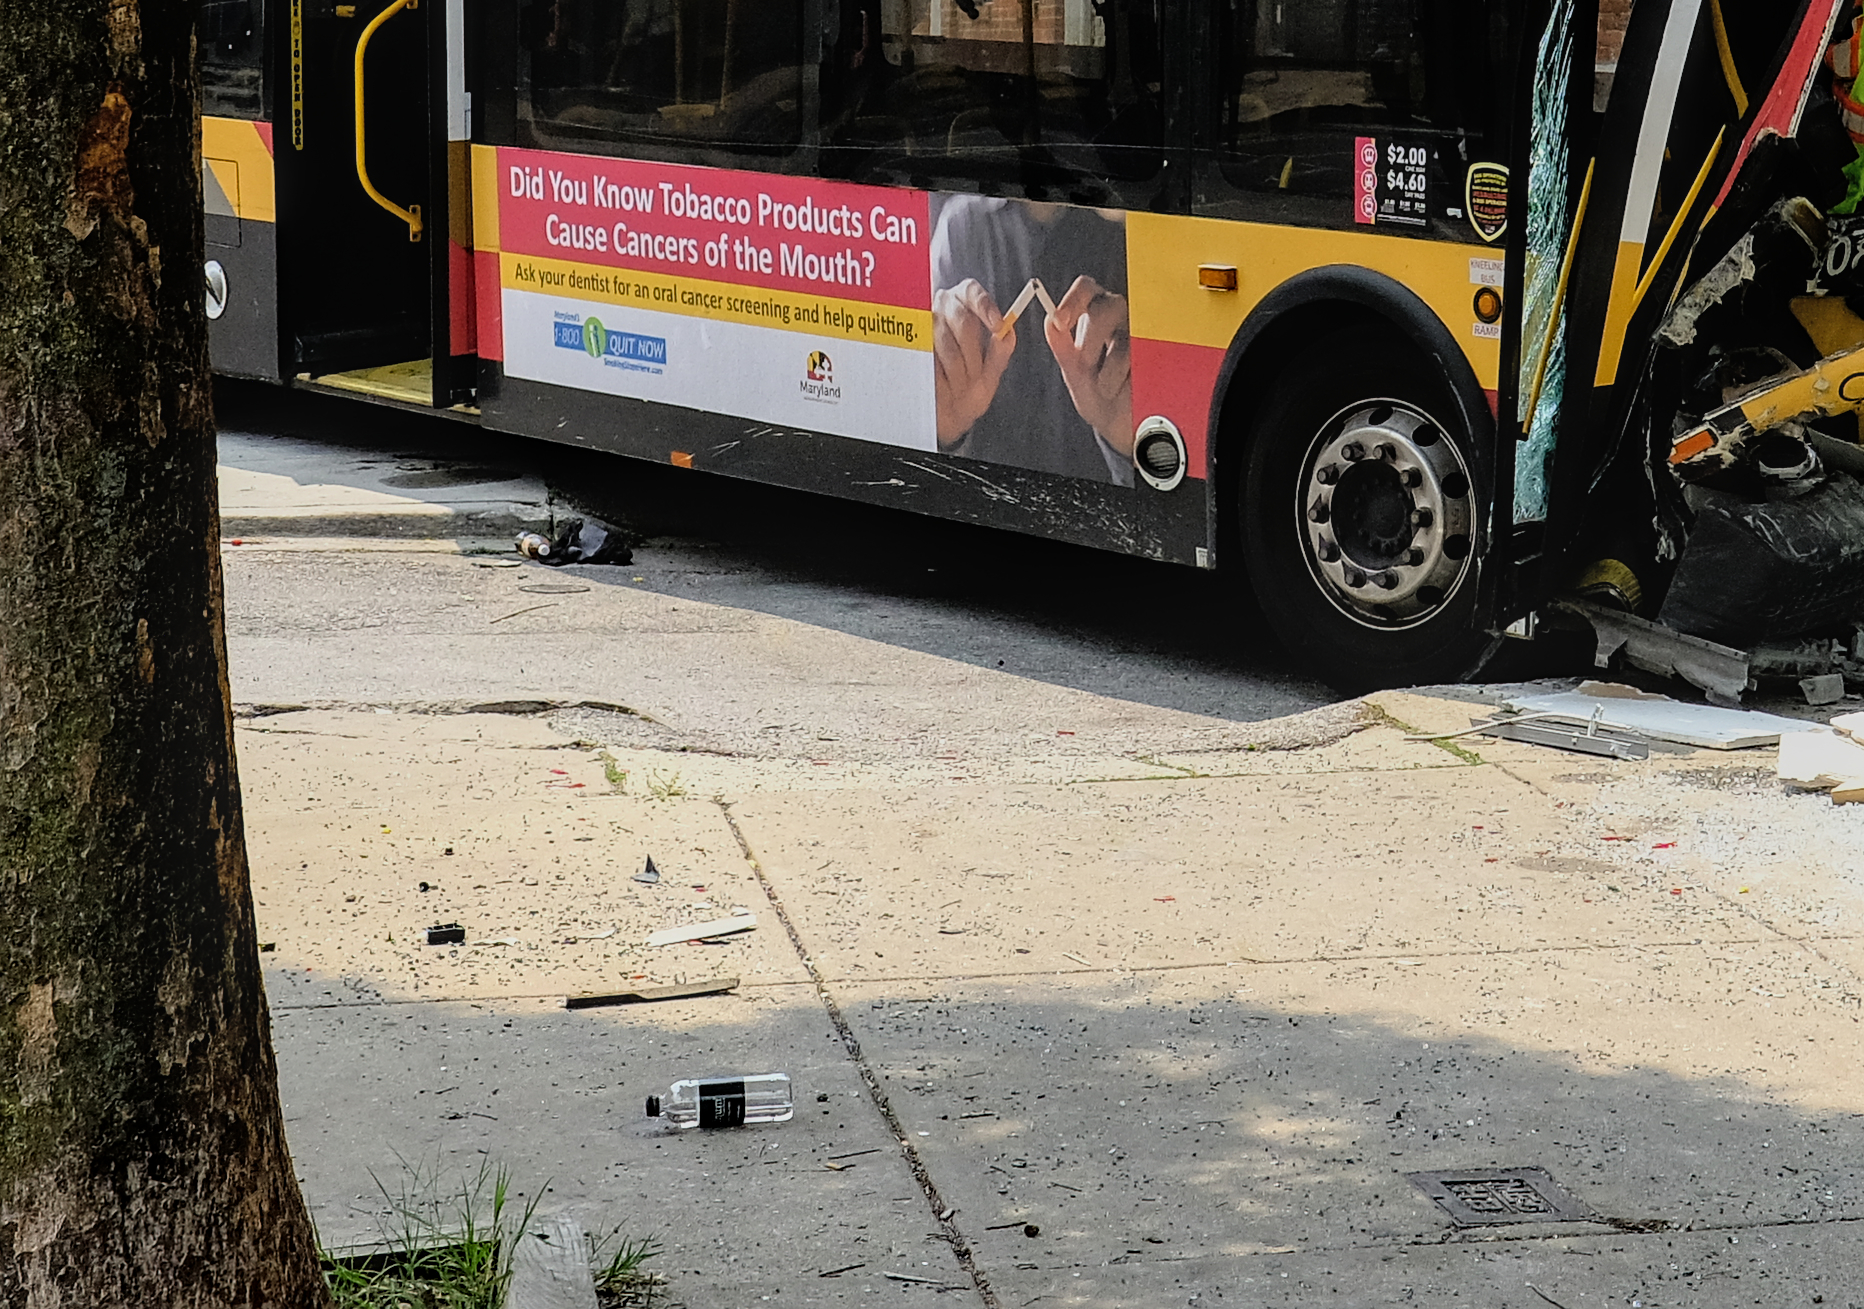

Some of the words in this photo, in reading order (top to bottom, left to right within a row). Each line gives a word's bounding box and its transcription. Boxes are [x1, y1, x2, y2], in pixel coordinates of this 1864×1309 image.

[293, 38, 300, 59] TO
[293, 63, 301, 102] OPEN
[294, 109, 302, 146] DOOR
[1387, 143, 1427, 166] $2.00
[1386, 168, 1427, 192] $4.60
[510, 165, 544, 201] Did
[548, 170, 588, 207] You
[593, 174, 654, 214] Know
[658, 182, 751, 226] Tobacco
[757, 193, 863, 239] Products
[869, 206, 918, 246] Can
[545, 213, 608, 253] Cause
[613, 222, 699, 265] Cancers
[704, 233, 729, 269] of
[733, 235, 773, 274] the
[779, 242, 876, 288] Mouth?
[1480, 273, 1496, 284] BUS
[515, 262, 536, 283] Ask
[538, 270, 566, 288] your
[568, 270, 610, 294] dentist
[612, 275, 630, 297] for
[634, 284, 650, 300] an
[653, 284, 678, 304] oral
[681, 290, 723, 310] cancer
[726, 294, 791, 324] screening
[794, 303, 819, 324] and
[823, 307, 854, 333] help
[857, 312, 919, 343] quitting.
[555, 327, 580, 346] 1-800
[609, 334, 636, 356] QUIT
[638, 339, 665, 359] NOW
[1473, 324, 1500, 337] RAMP
[799, 380, 841, 399] Maryland
